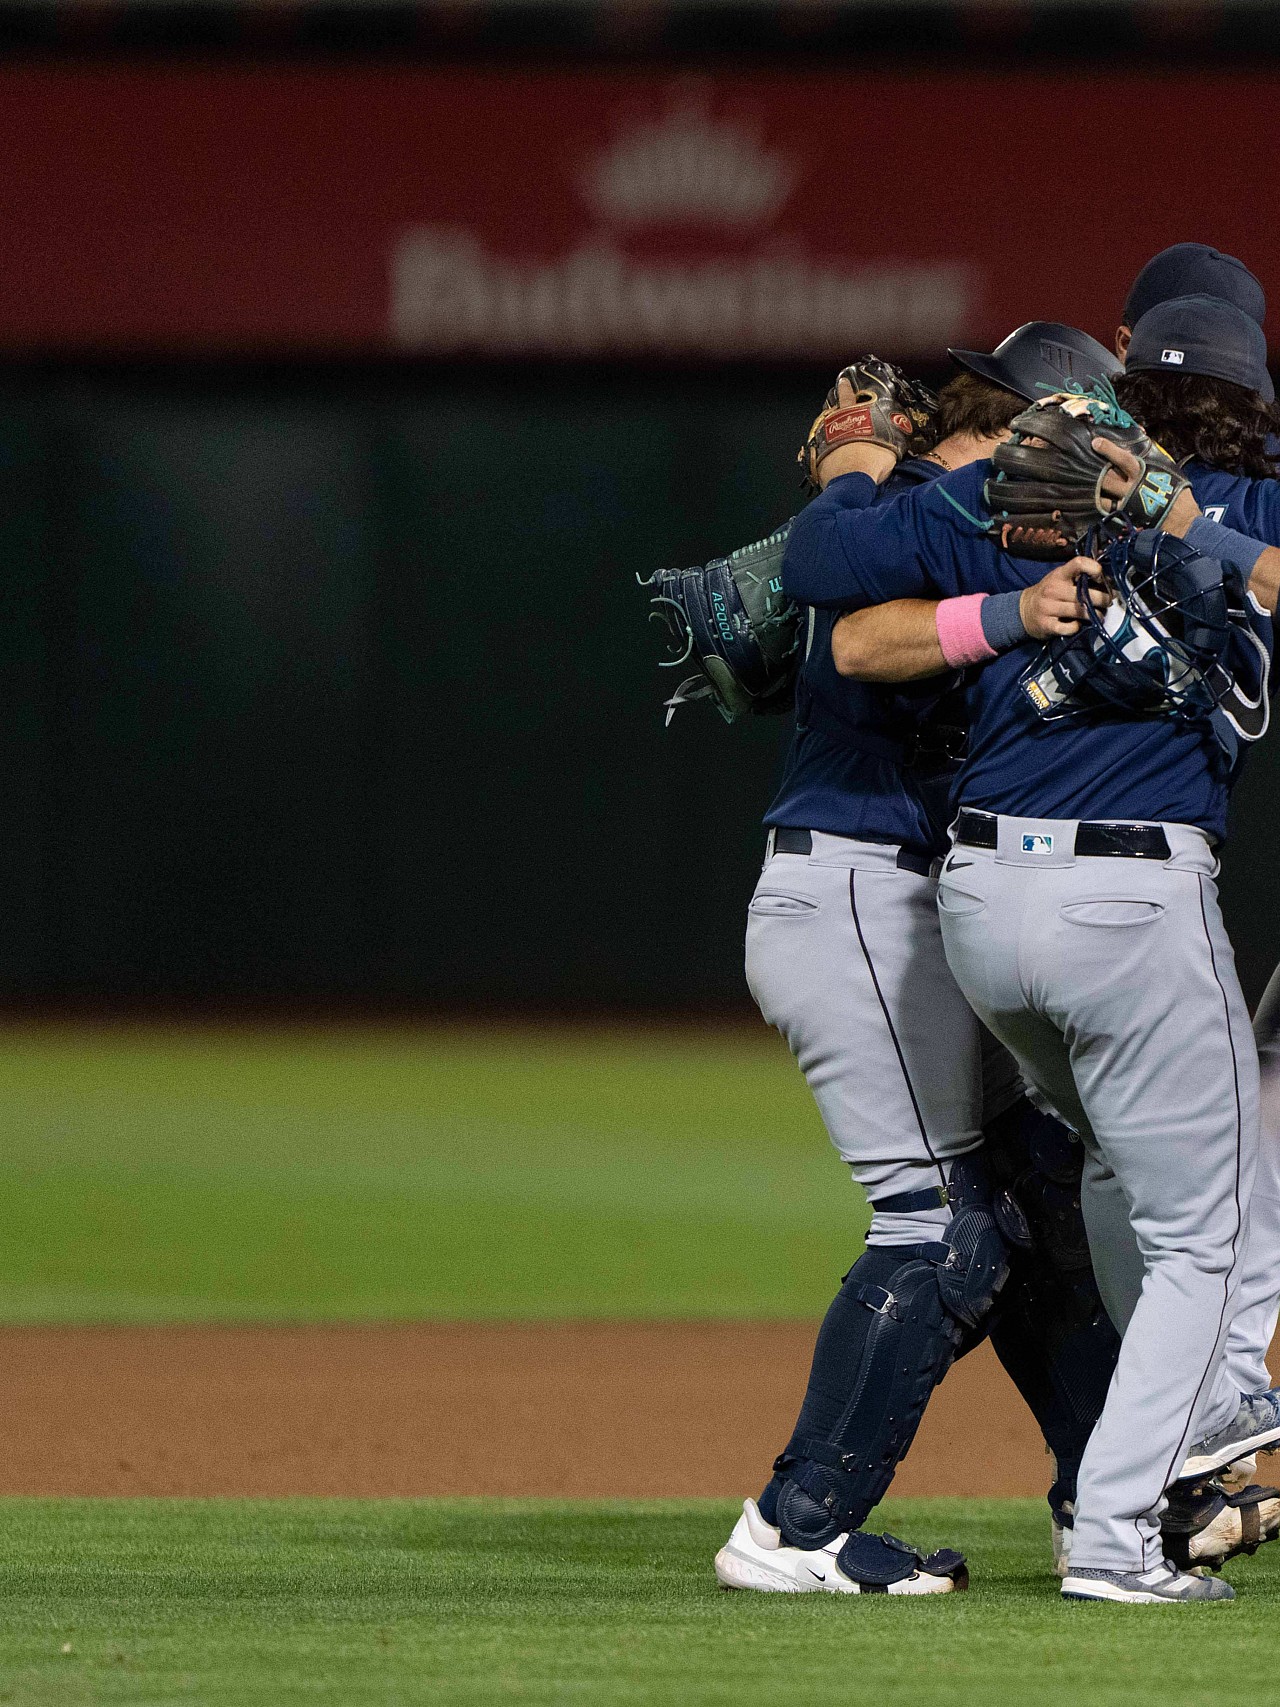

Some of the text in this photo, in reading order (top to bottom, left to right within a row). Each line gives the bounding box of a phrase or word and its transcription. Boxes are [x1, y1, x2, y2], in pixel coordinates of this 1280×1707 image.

[829, 415, 867, 434] Rawlings
[1139, 472, 1174, 517] 44
[711, 591, 734, 641] A2000
